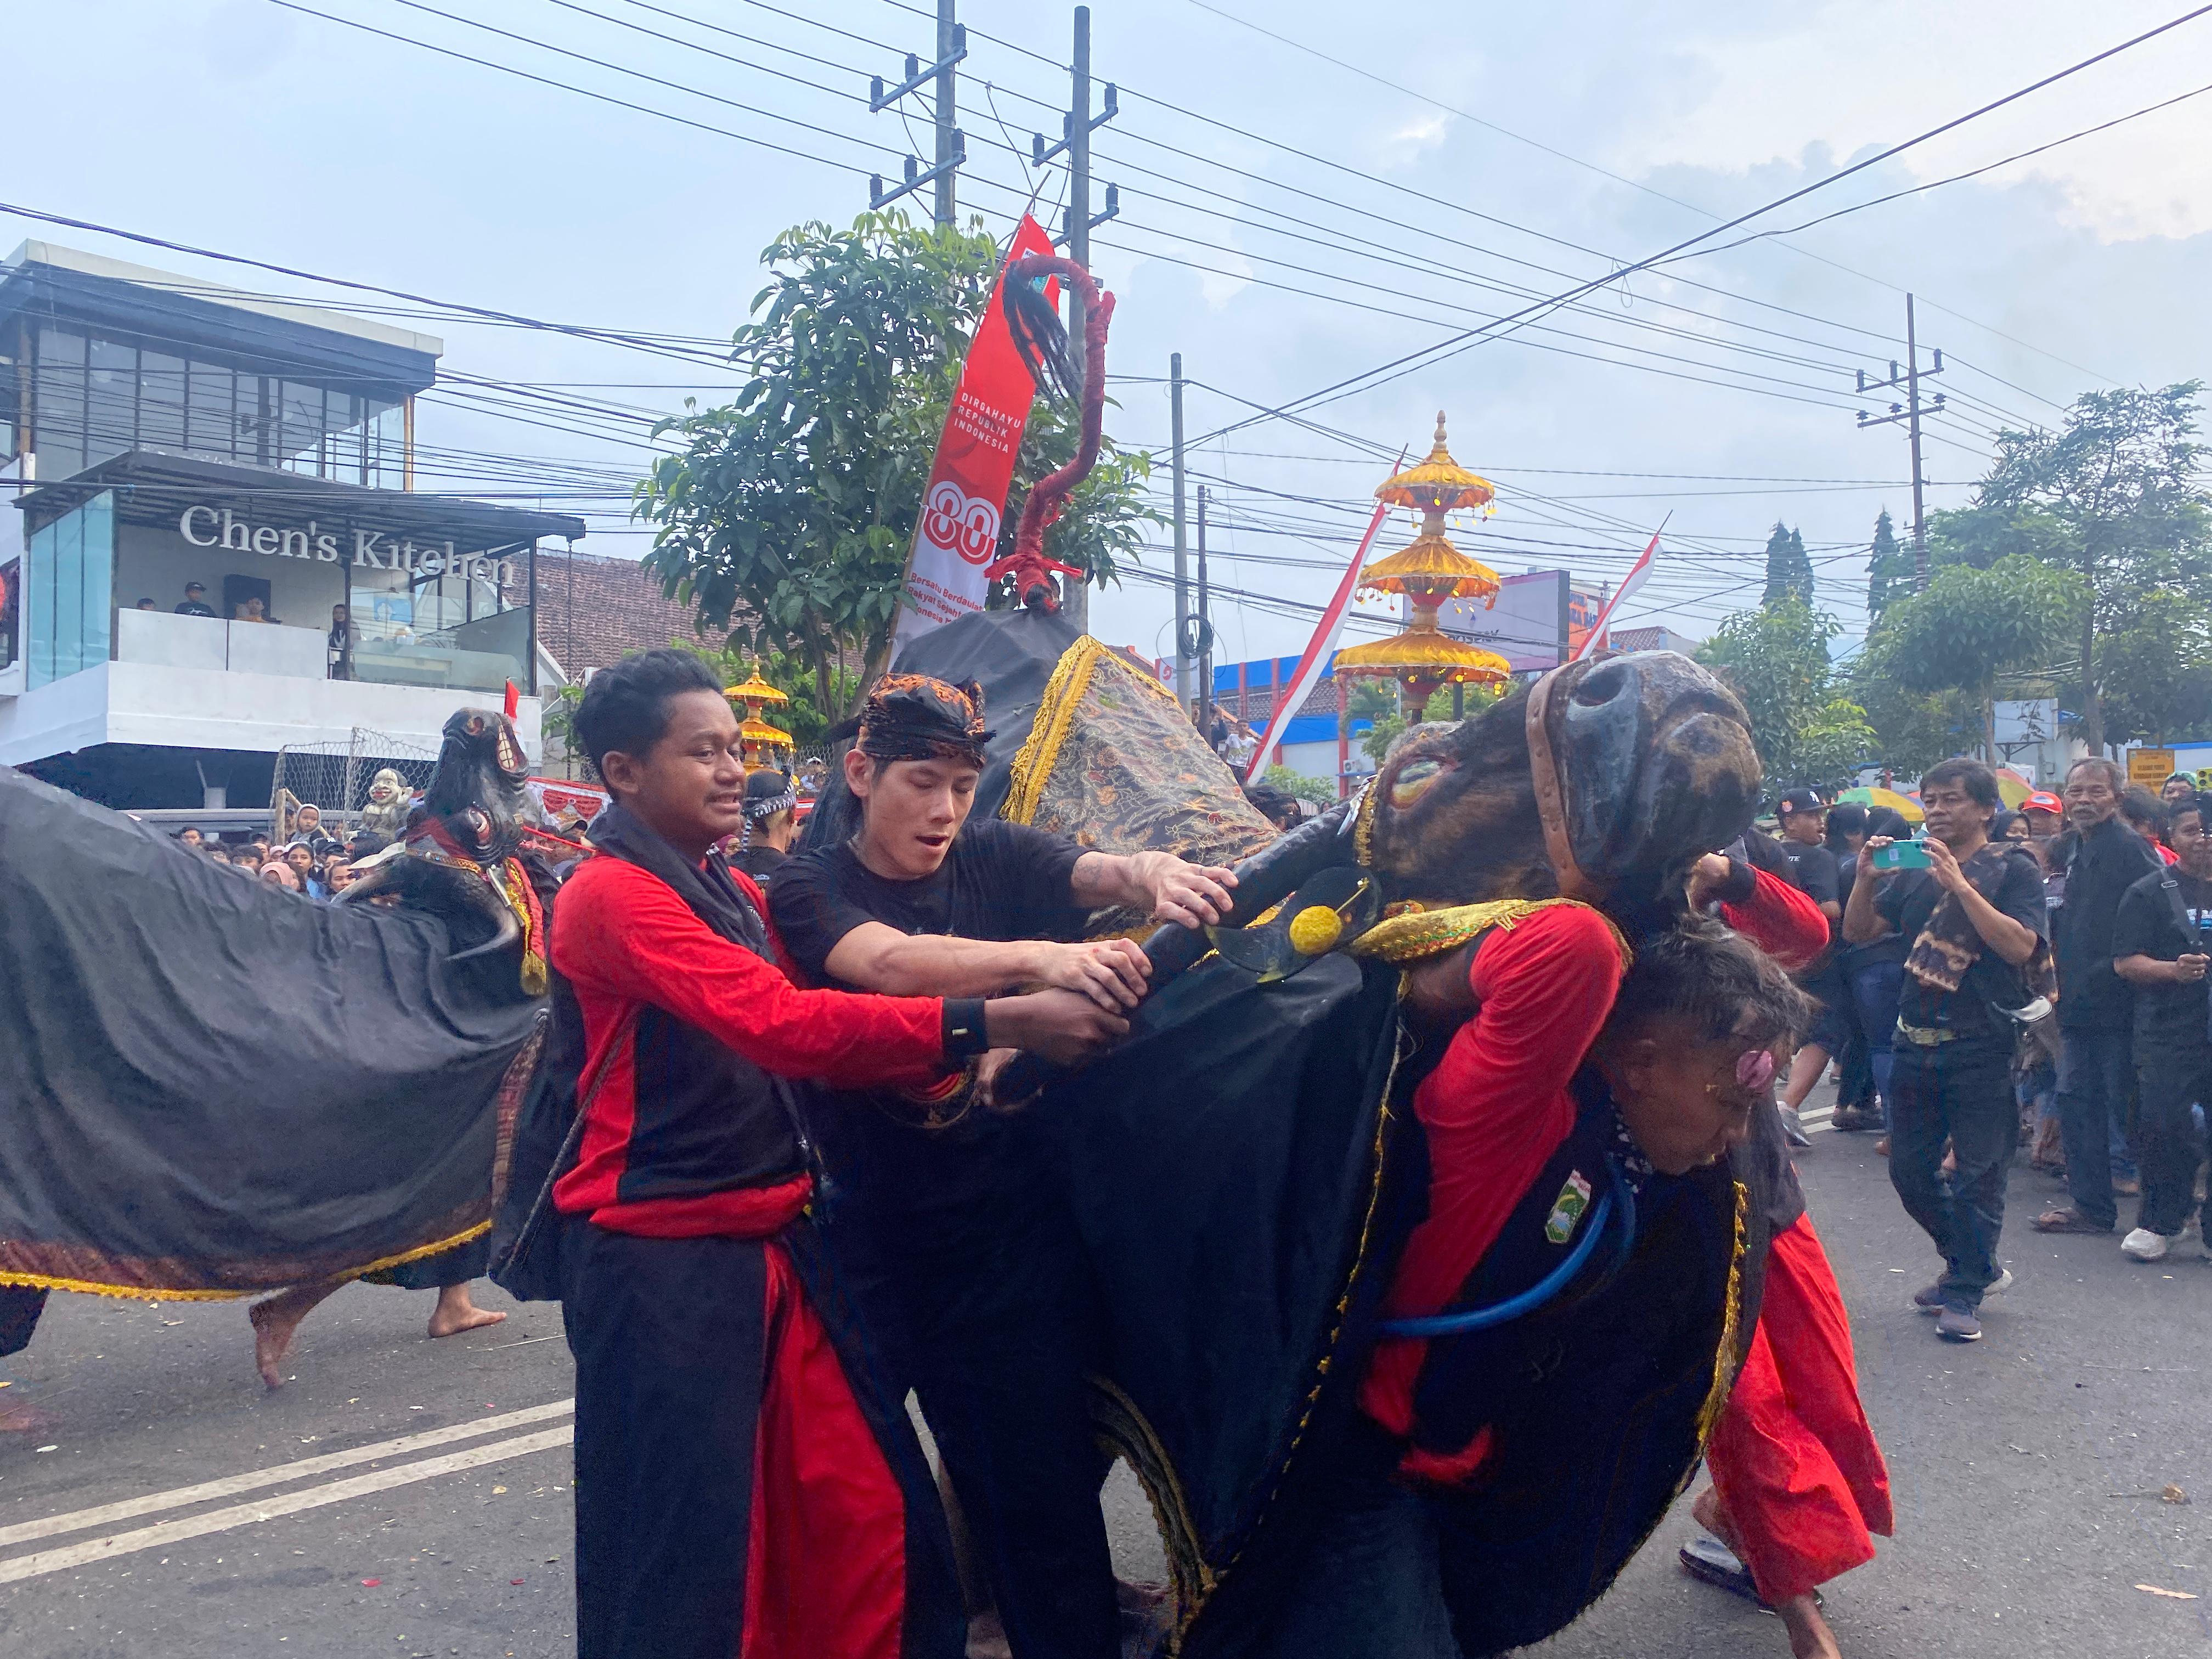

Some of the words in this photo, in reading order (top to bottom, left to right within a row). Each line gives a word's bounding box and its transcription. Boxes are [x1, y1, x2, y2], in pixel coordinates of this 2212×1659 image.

[958, 405, 1008, 438] REPUBLIK
[962, 392, 1021, 428] DIRGAHAYU
[955, 418, 1008, 453] INDONESIA
[923, 481, 1000, 565] 80
[180, 505, 338, 562] Chen's
[352, 528, 515, 586] Kitchen
[908, 586, 936, 605] Rakyat
[937, 600, 964, 618] Sejaht
[911, 572, 942, 594] Bersatu
[943, 588, 982, 611] Berdaulat
